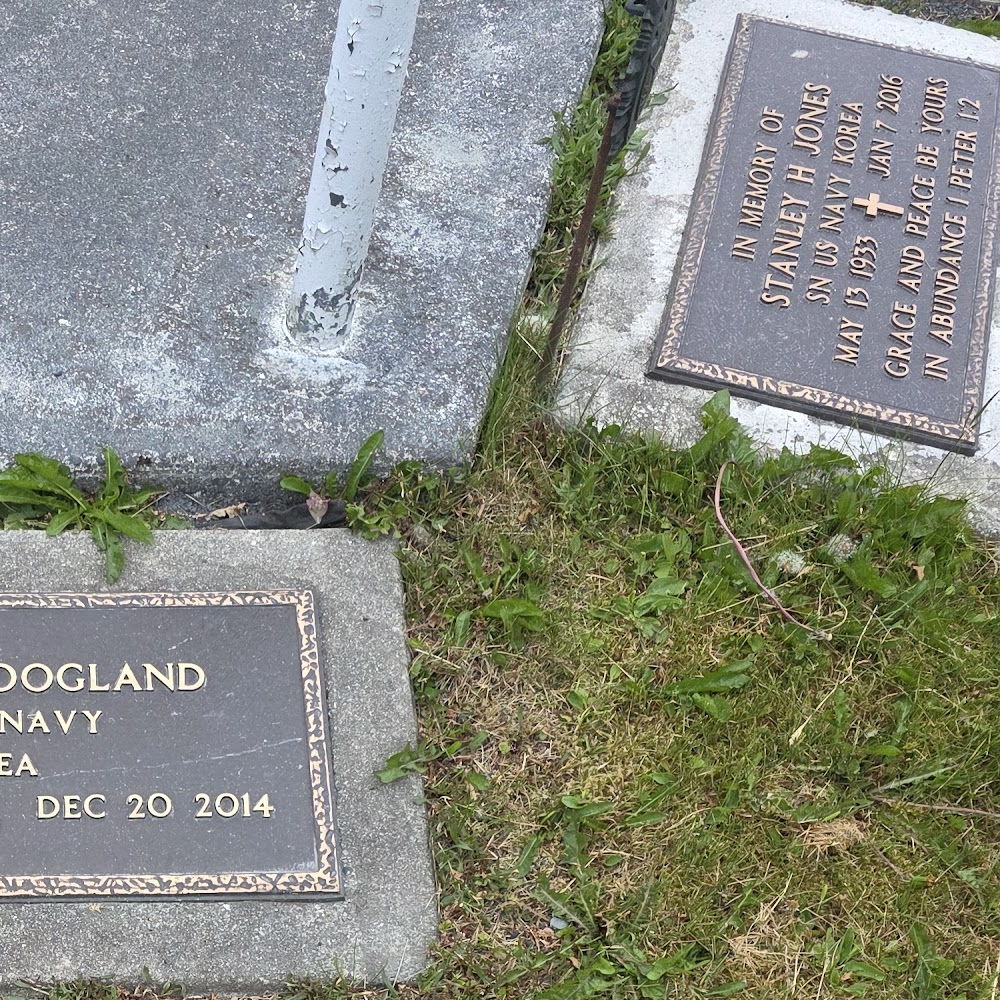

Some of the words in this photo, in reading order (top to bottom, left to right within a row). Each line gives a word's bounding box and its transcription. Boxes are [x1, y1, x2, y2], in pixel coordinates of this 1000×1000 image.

[876, 74, 903, 115] 2016
[921, 77, 949, 134] YOURS
[957, 98, 980, 122] 1:2
[760, 106, 784, 133] OF
[792, 82, 831, 157] JONES
[832, 102, 863, 166] KOREA
[875, 119, 897, 133] 7
[786, 164, 815, 184] H
[867, 138, 894, 180] JAN
[916, 144, 939, 169] BE
[948, 131, 977, 190] PETER
[739, 142, 777, 229] MEMORY
[820, 172, 850, 233] NAVY
[905, 175, 935, 237] PEACE
[732, 235, 758, 261] IN
[760, 192, 809, 308] STANLEY
[814, 240, 839, 267] US
[850, 235, 878, 279] 1933
[805, 275, 832, 305] SN
[898, 246, 925, 294] AND
[928, 212, 966, 346] ABUNDANCE
[844, 287, 869, 309] 13
[833, 316, 864, 366] MAY
[884, 301, 917, 378] GRACE
[923, 353, 949, 381] IN
[36, 794, 106, 820] DEC
[128, 793, 172, 819] 20
[194, 793, 275, 819] 2014
